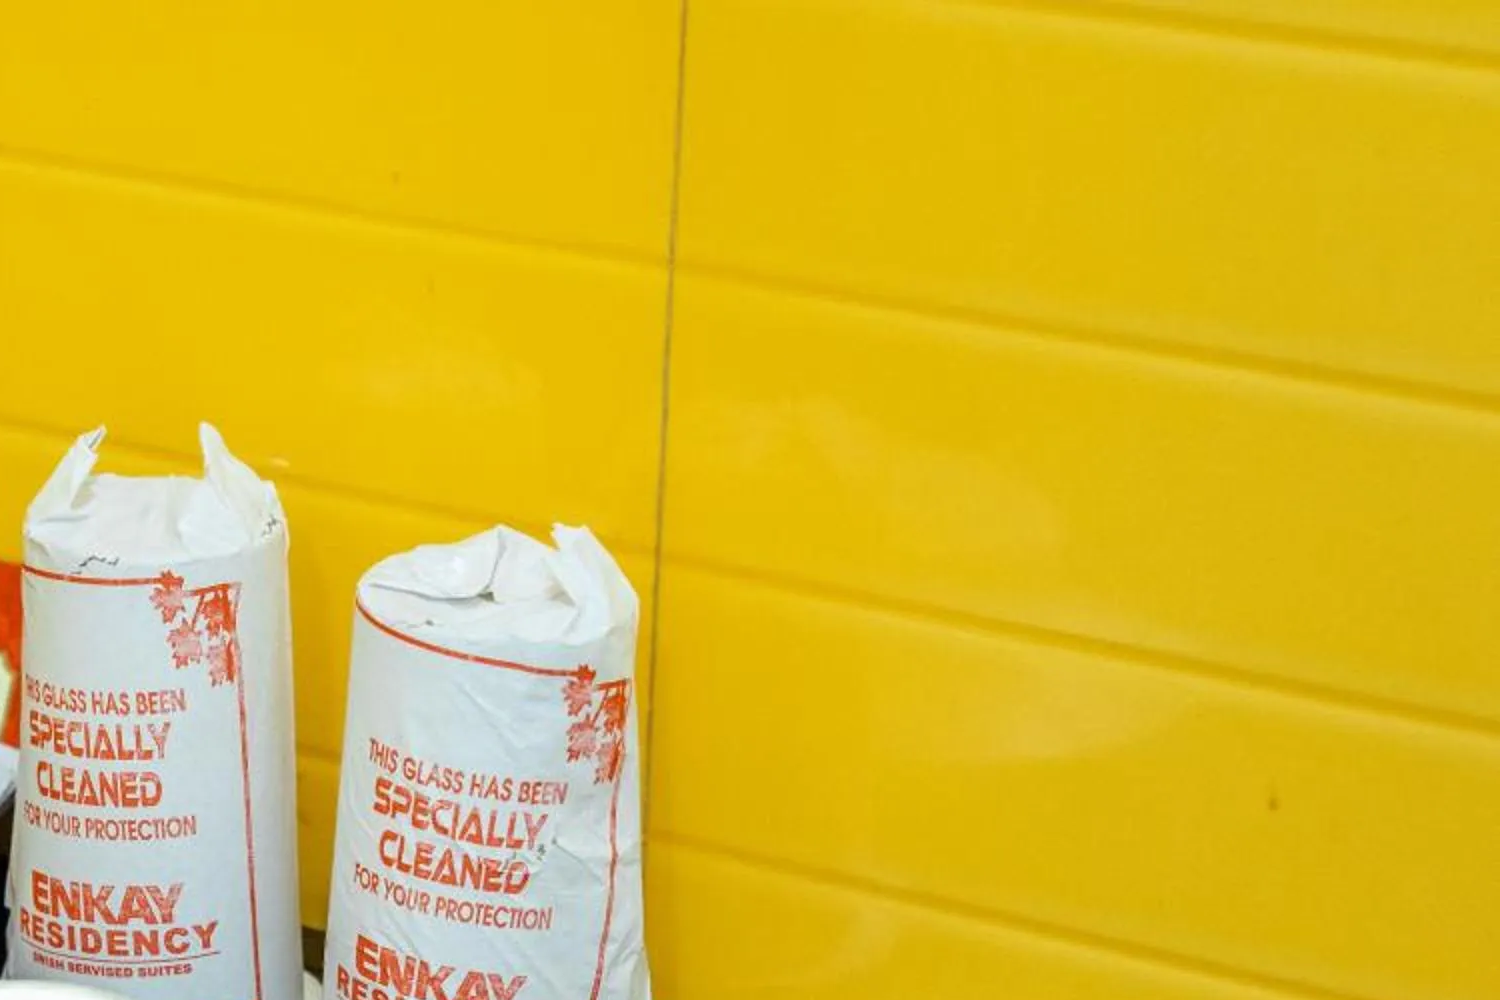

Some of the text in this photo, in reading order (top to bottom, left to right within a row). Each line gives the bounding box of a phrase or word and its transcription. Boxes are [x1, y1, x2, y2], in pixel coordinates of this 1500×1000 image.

[43, 682, 86, 713] GLASS
[91, 690, 130, 716] HAS
[135, 687, 187, 715] BEEN
[29, 709, 171, 760] SPECIALLY
[36, 760, 163, 808] CLEANED
[369, 737, 568, 805] THIS GLASS HAS BEEN
[43, 808, 81, 838] YOUR
[85, 815, 197, 841] PROTECTION
[373, 776, 548, 850] SPECIALLY
[379, 829, 530, 895] CLEANED
[32, 868, 184, 925] ENKAY
[353, 862, 553, 930] FOR YOUR PROTECTION
[19, 906, 219, 957] RESIDENCY
[138, 963, 193, 978] SUITES
